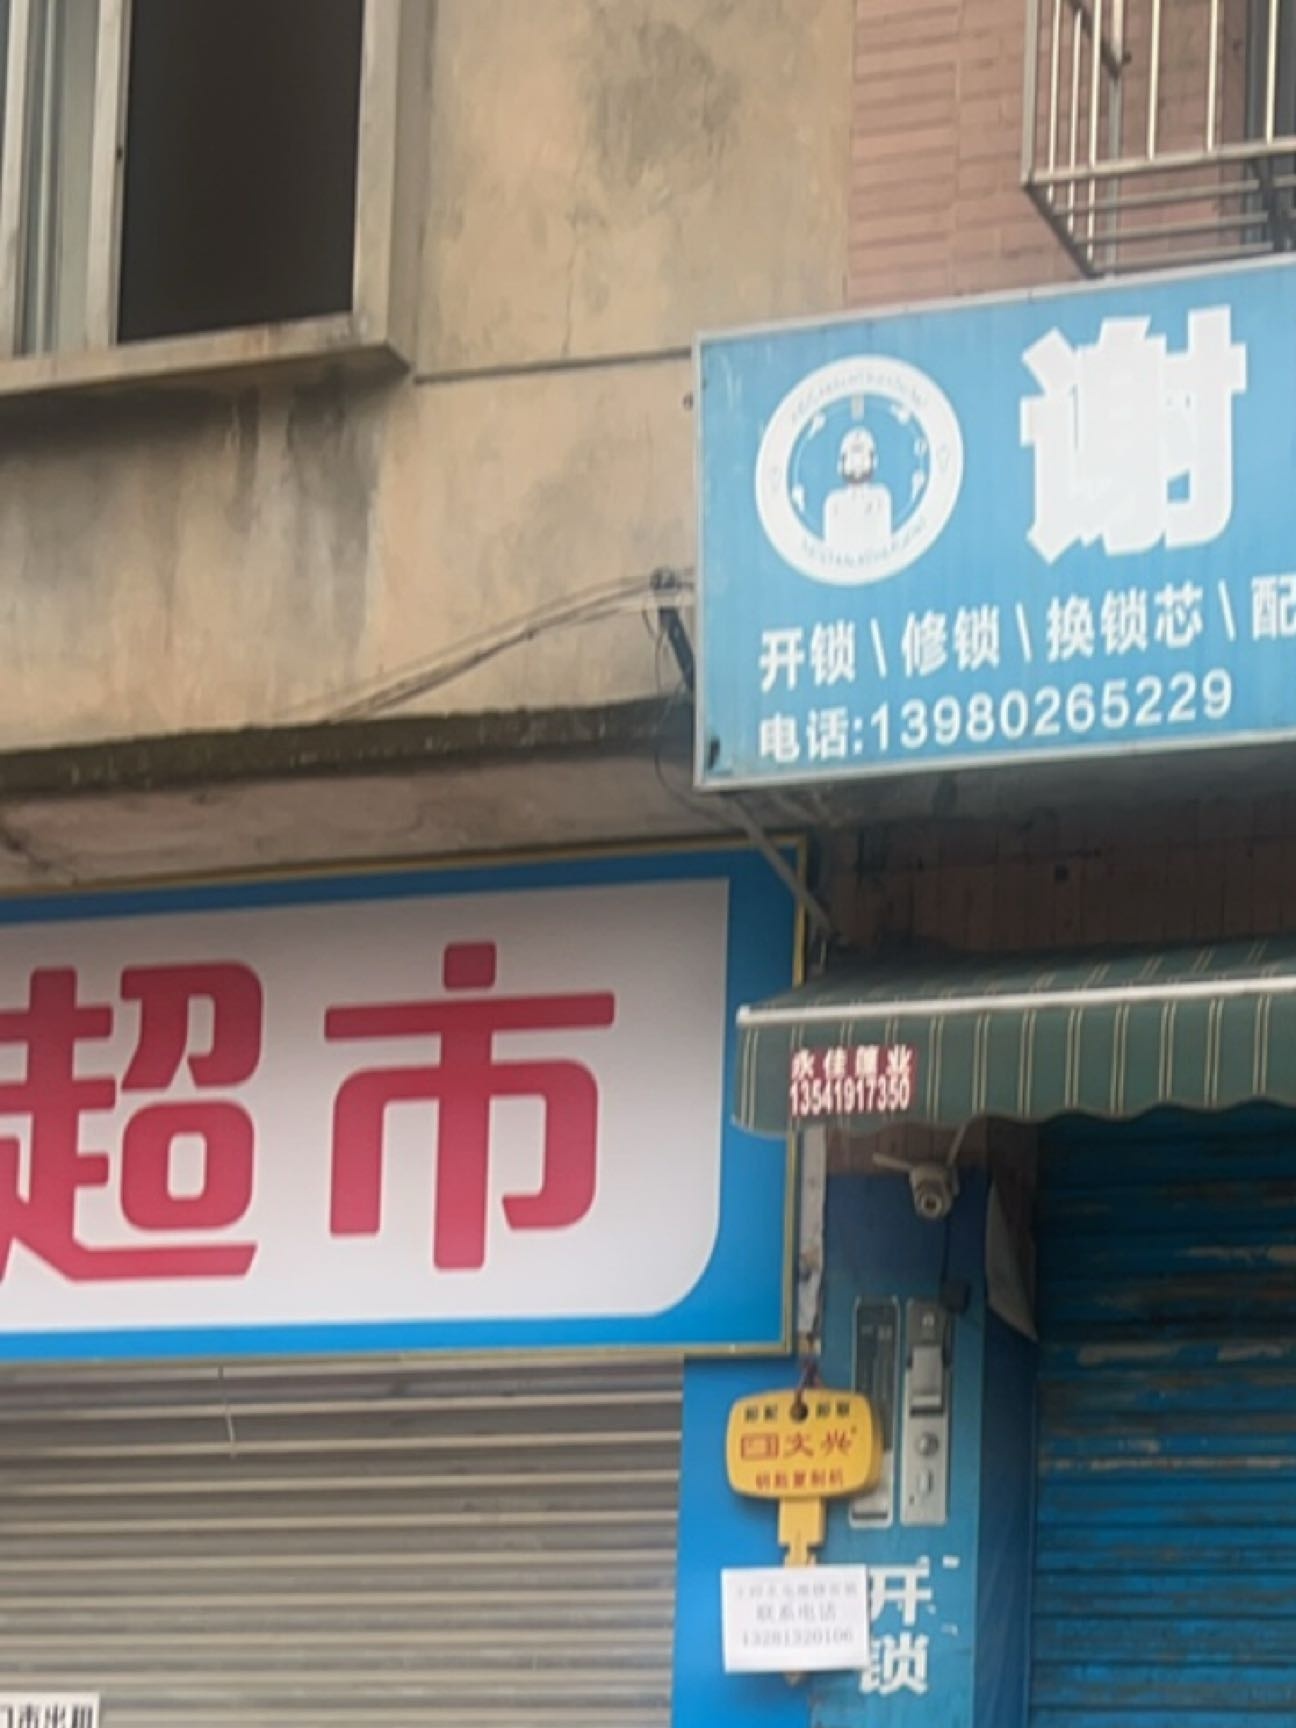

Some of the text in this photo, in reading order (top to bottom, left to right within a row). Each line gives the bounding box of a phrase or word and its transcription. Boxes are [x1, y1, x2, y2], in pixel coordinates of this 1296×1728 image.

[758, 669, 1232, 764] 电话:13980265229
[0, 940, 614, 1281] 超市
[790, 1076, 910, 1116] 13541917350
